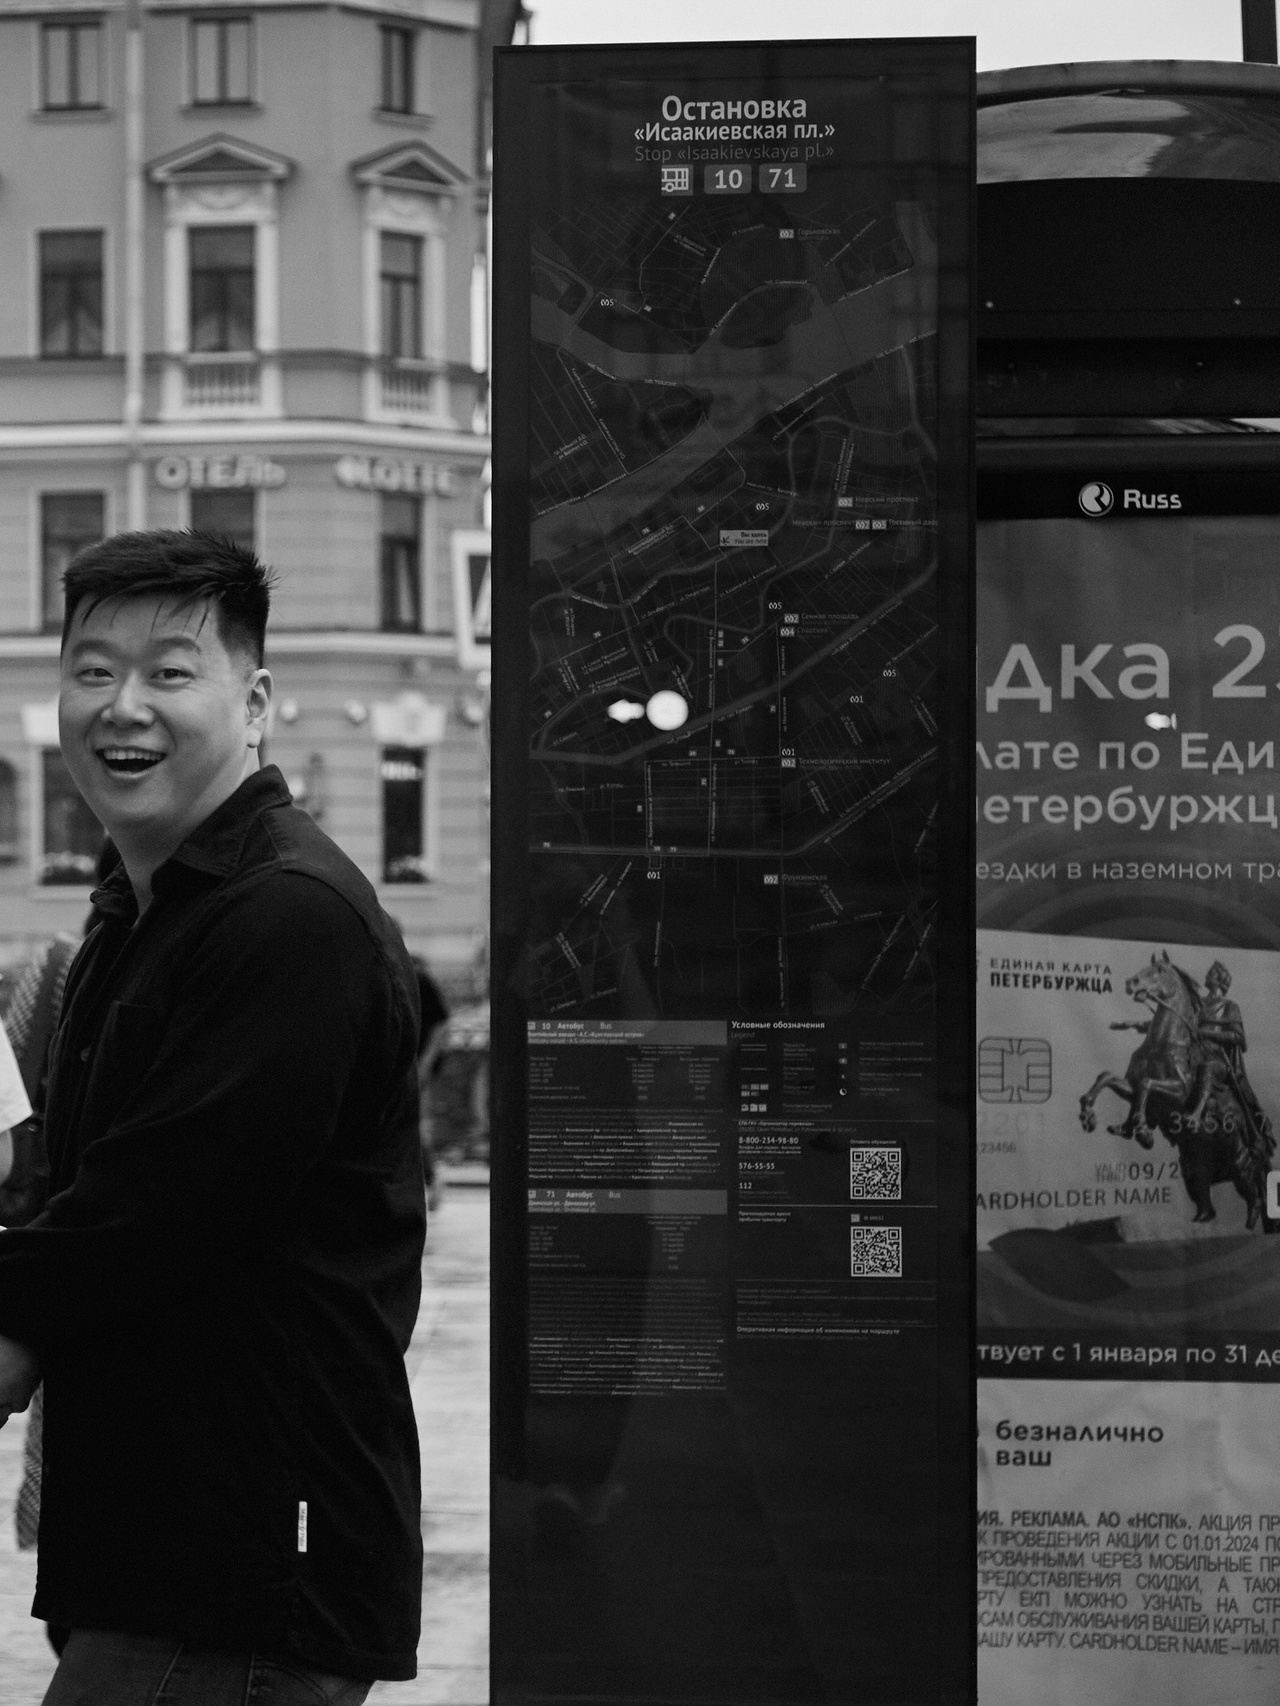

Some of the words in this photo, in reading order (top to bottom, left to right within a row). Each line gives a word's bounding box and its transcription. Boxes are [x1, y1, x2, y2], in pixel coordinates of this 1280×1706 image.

[662, 95, 807, 121] Остановка
[634, 123, 787, 142] «Исаакиевская
[794, 123, 835, 139] пл.»
[635, 146, 671, 163] Stop
[677, 144, 799, 162] «Isaakievskaya
[805, 143, 834, 161] pl.»
[714, 169, 743, 190] 10
[768, 168, 796, 189] 71
[1123, 489, 1182, 510] Russ
[1212, 623, 1280, 698] 2
[1098, 740, 1161, 770] по
[1181, 732, 1274, 775] Еди
[976, 785, 1278, 831] етербуржц
[1067, 863, 1082, 879] в
[1092, 863, 1232, 879] наземном
[990, 957, 1055, 971] ЕДИНАЯ
[1062, 962, 1112, 975] КАРТА
[990, 972, 1113, 994] ПЕТЕРБУРЖЦА
[557, 1023, 584, 1031] Автобус
[731, 1021, 772, 1029] Условные
[773, 1021, 825, 1029] обозначения
[1169, 1110, 1235, 1134] 3456
[738, 1136, 799, 1144] 8-800-234-98-80
[738, 1162, 775, 1171] 576-55-55
[566, 1191, 593, 1199] Автобус
[1113, 1186, 1173, 1206] NAME
[977, 1344, 1044, 1364] твует
[1052, 1347, 1065, 1361] с
[1072, 1342, 1081, 1361] 1
[1090, 1346, 1177, 1366] января
[1186, 1347, 1216, 1363] по
[1225, 1344, 1248, 1364] 31
[995, 1420, 1164, 1443] безналично
[996, 1450, 1052, 1467] ваш
[1097, 1511, 1121, 1528] АО
[1198, 1514, 1252, 1535] АКЦИЯ
[993, 1530, 1100, 1550] ПРОВЕДЕНИЯ
[1106, 1532, 1159, 1552] АКЦИИ
[1166, 1533, 1177, 1550] С
[1183, 1534, 1259, 1552] 01.01.2024
[1091, 1551, 1142, 1569] ЧЕРЕЗ
[1149, 1554, 1252, 1573] МОБИЛЬНЫЕ
[1136, 1573, 1203, 1594] СКИДКИ,
[1217, 1576, 1229, 1593] А
[1020, 1590, 1050, 1608] ЕКП
[1064, 1592, 1128, 1609] МОЖНО
[1142, 1594, 1202, 1613] УЗНАТЬ
[1217, 1597, 1239, 1614] НА
[1017, 1611, 1149, 1631] ОБСЛУЖИВАНИЯ
[1153, 1614, 1210, 1633] ВАШЕЙ
[1213, 1618, 1269, 1637] КАРТЫ,
[1069, 1632, 1179, 1653] CARDHOLDER
[1183, 1637, 1228, 1655] NAME
[1244, 1638, 1279, 1655] ИМЯ
